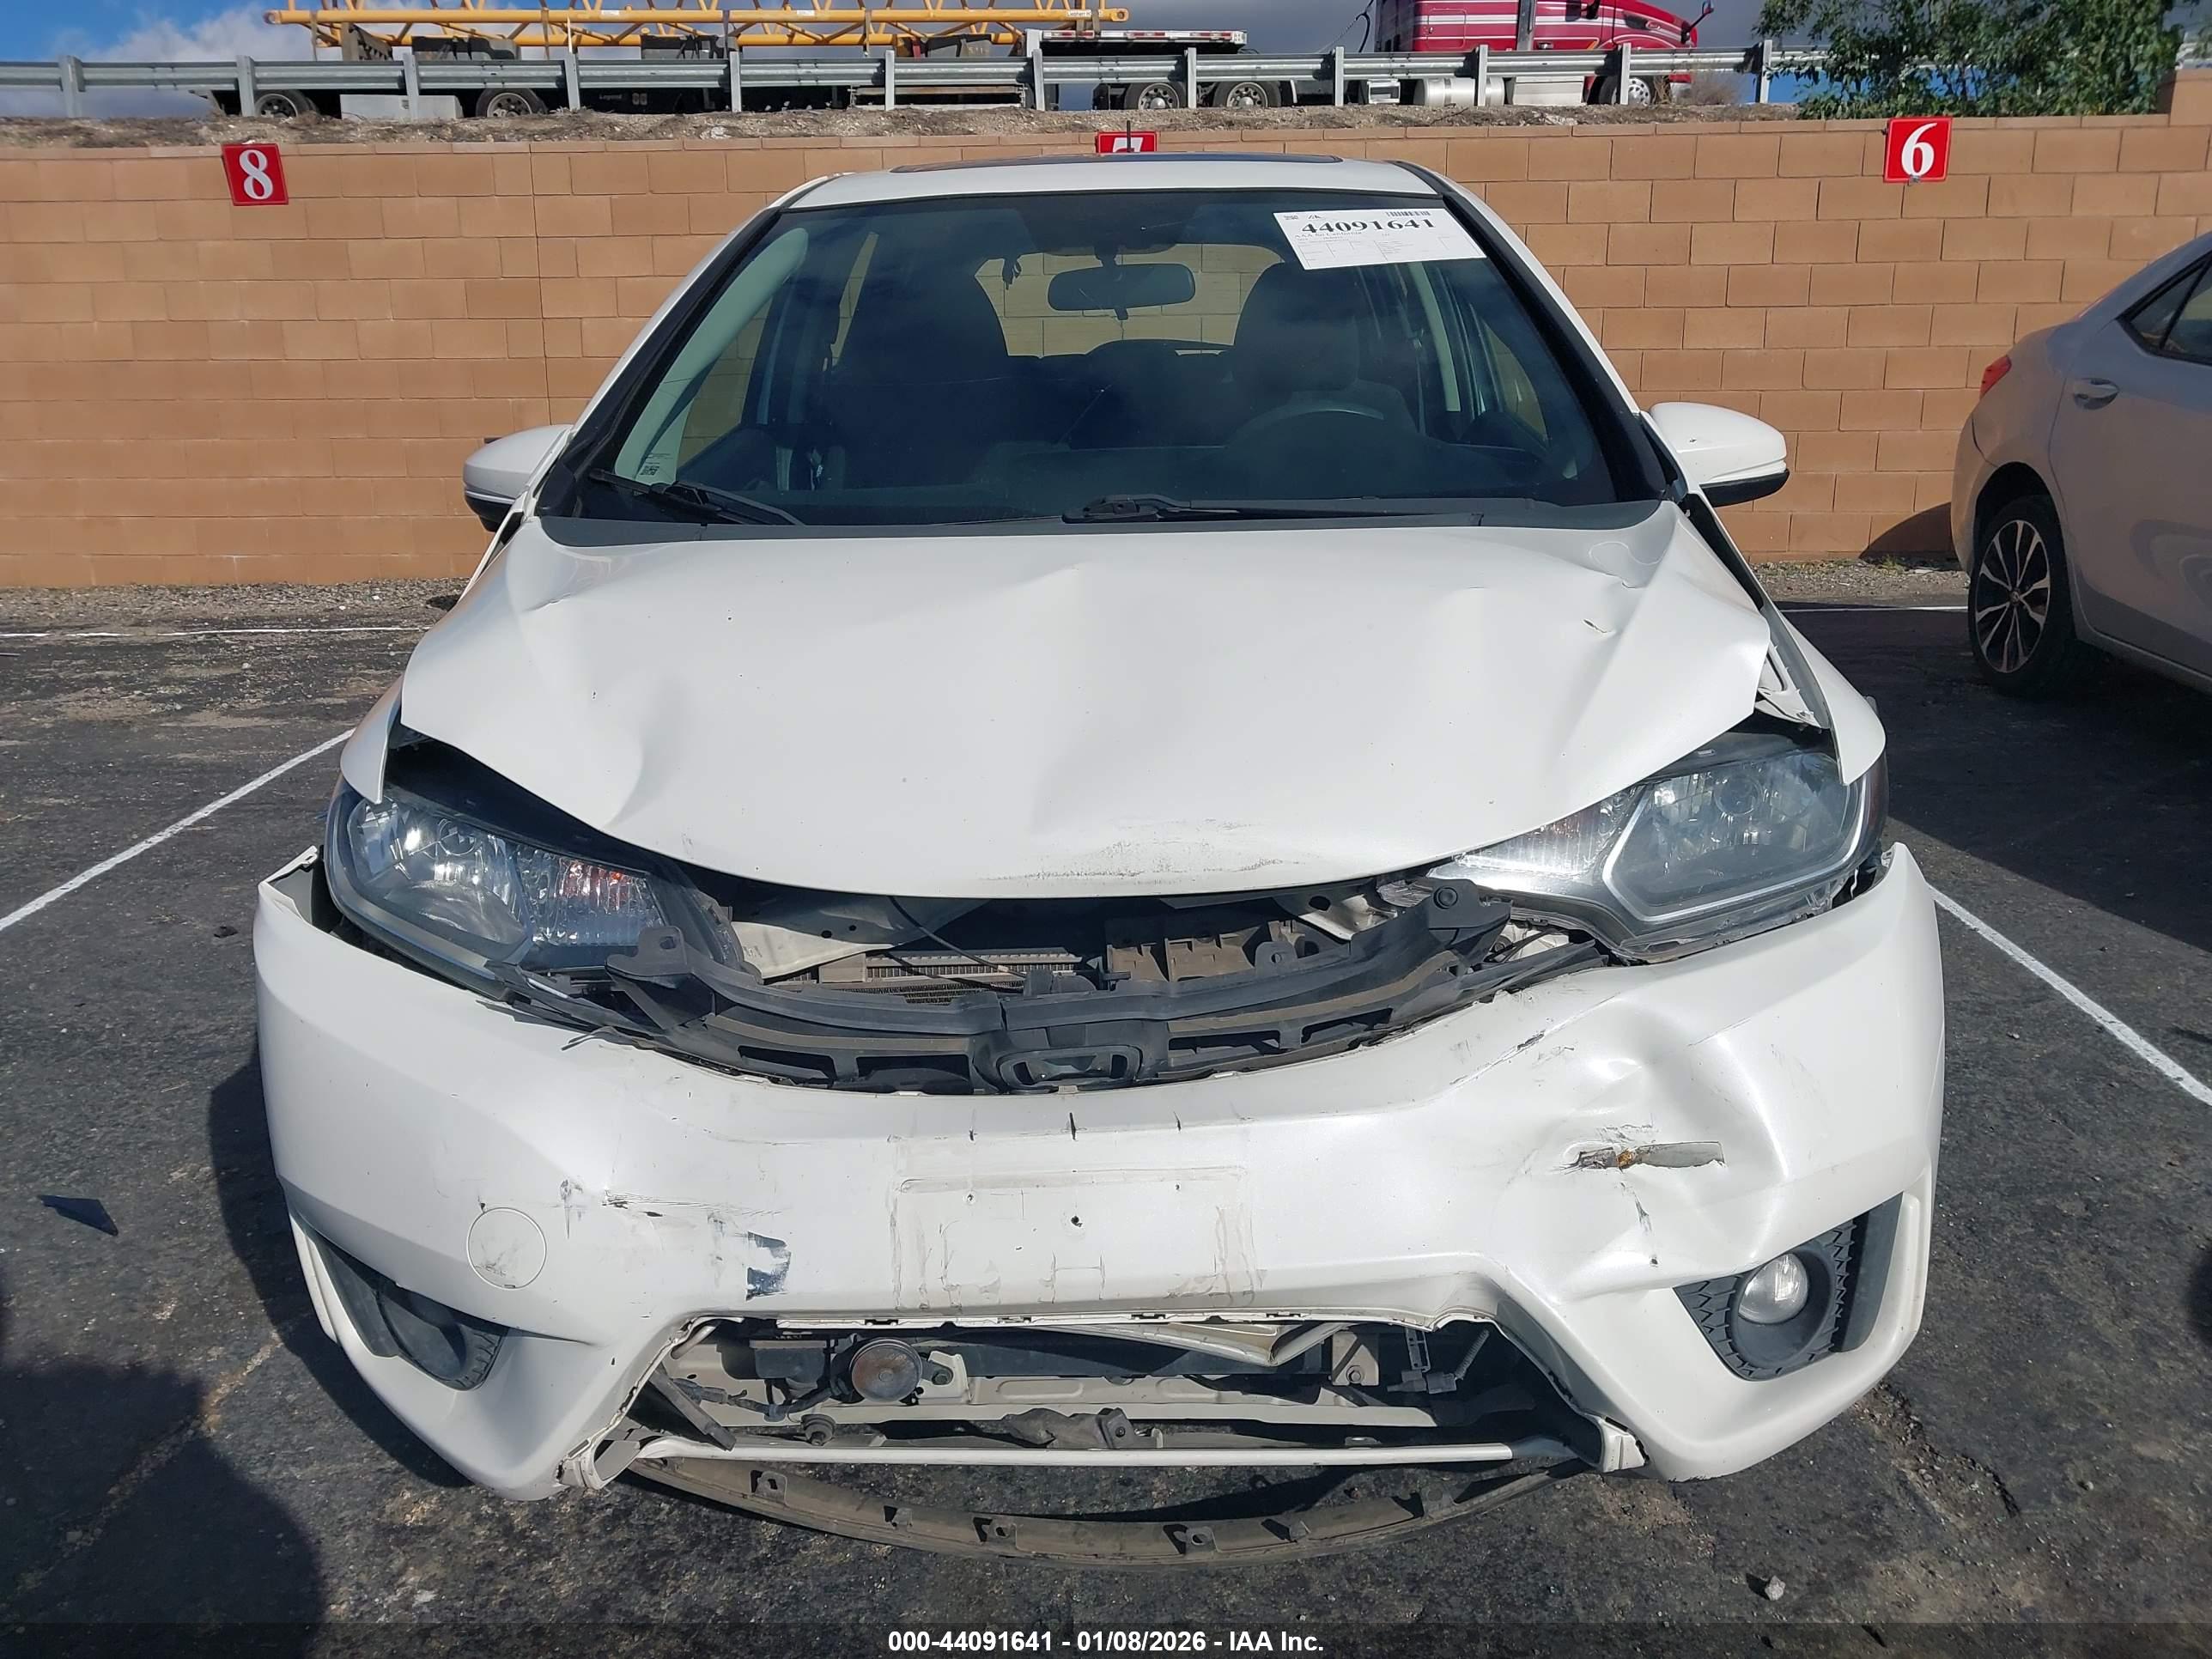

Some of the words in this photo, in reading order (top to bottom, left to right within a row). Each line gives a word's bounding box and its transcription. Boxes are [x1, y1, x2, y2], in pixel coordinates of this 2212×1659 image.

[239, 149, 274, 200] 8
[1901, 122, 1938, 177] 6
[1301, 218, 1436, 234] 44091641
